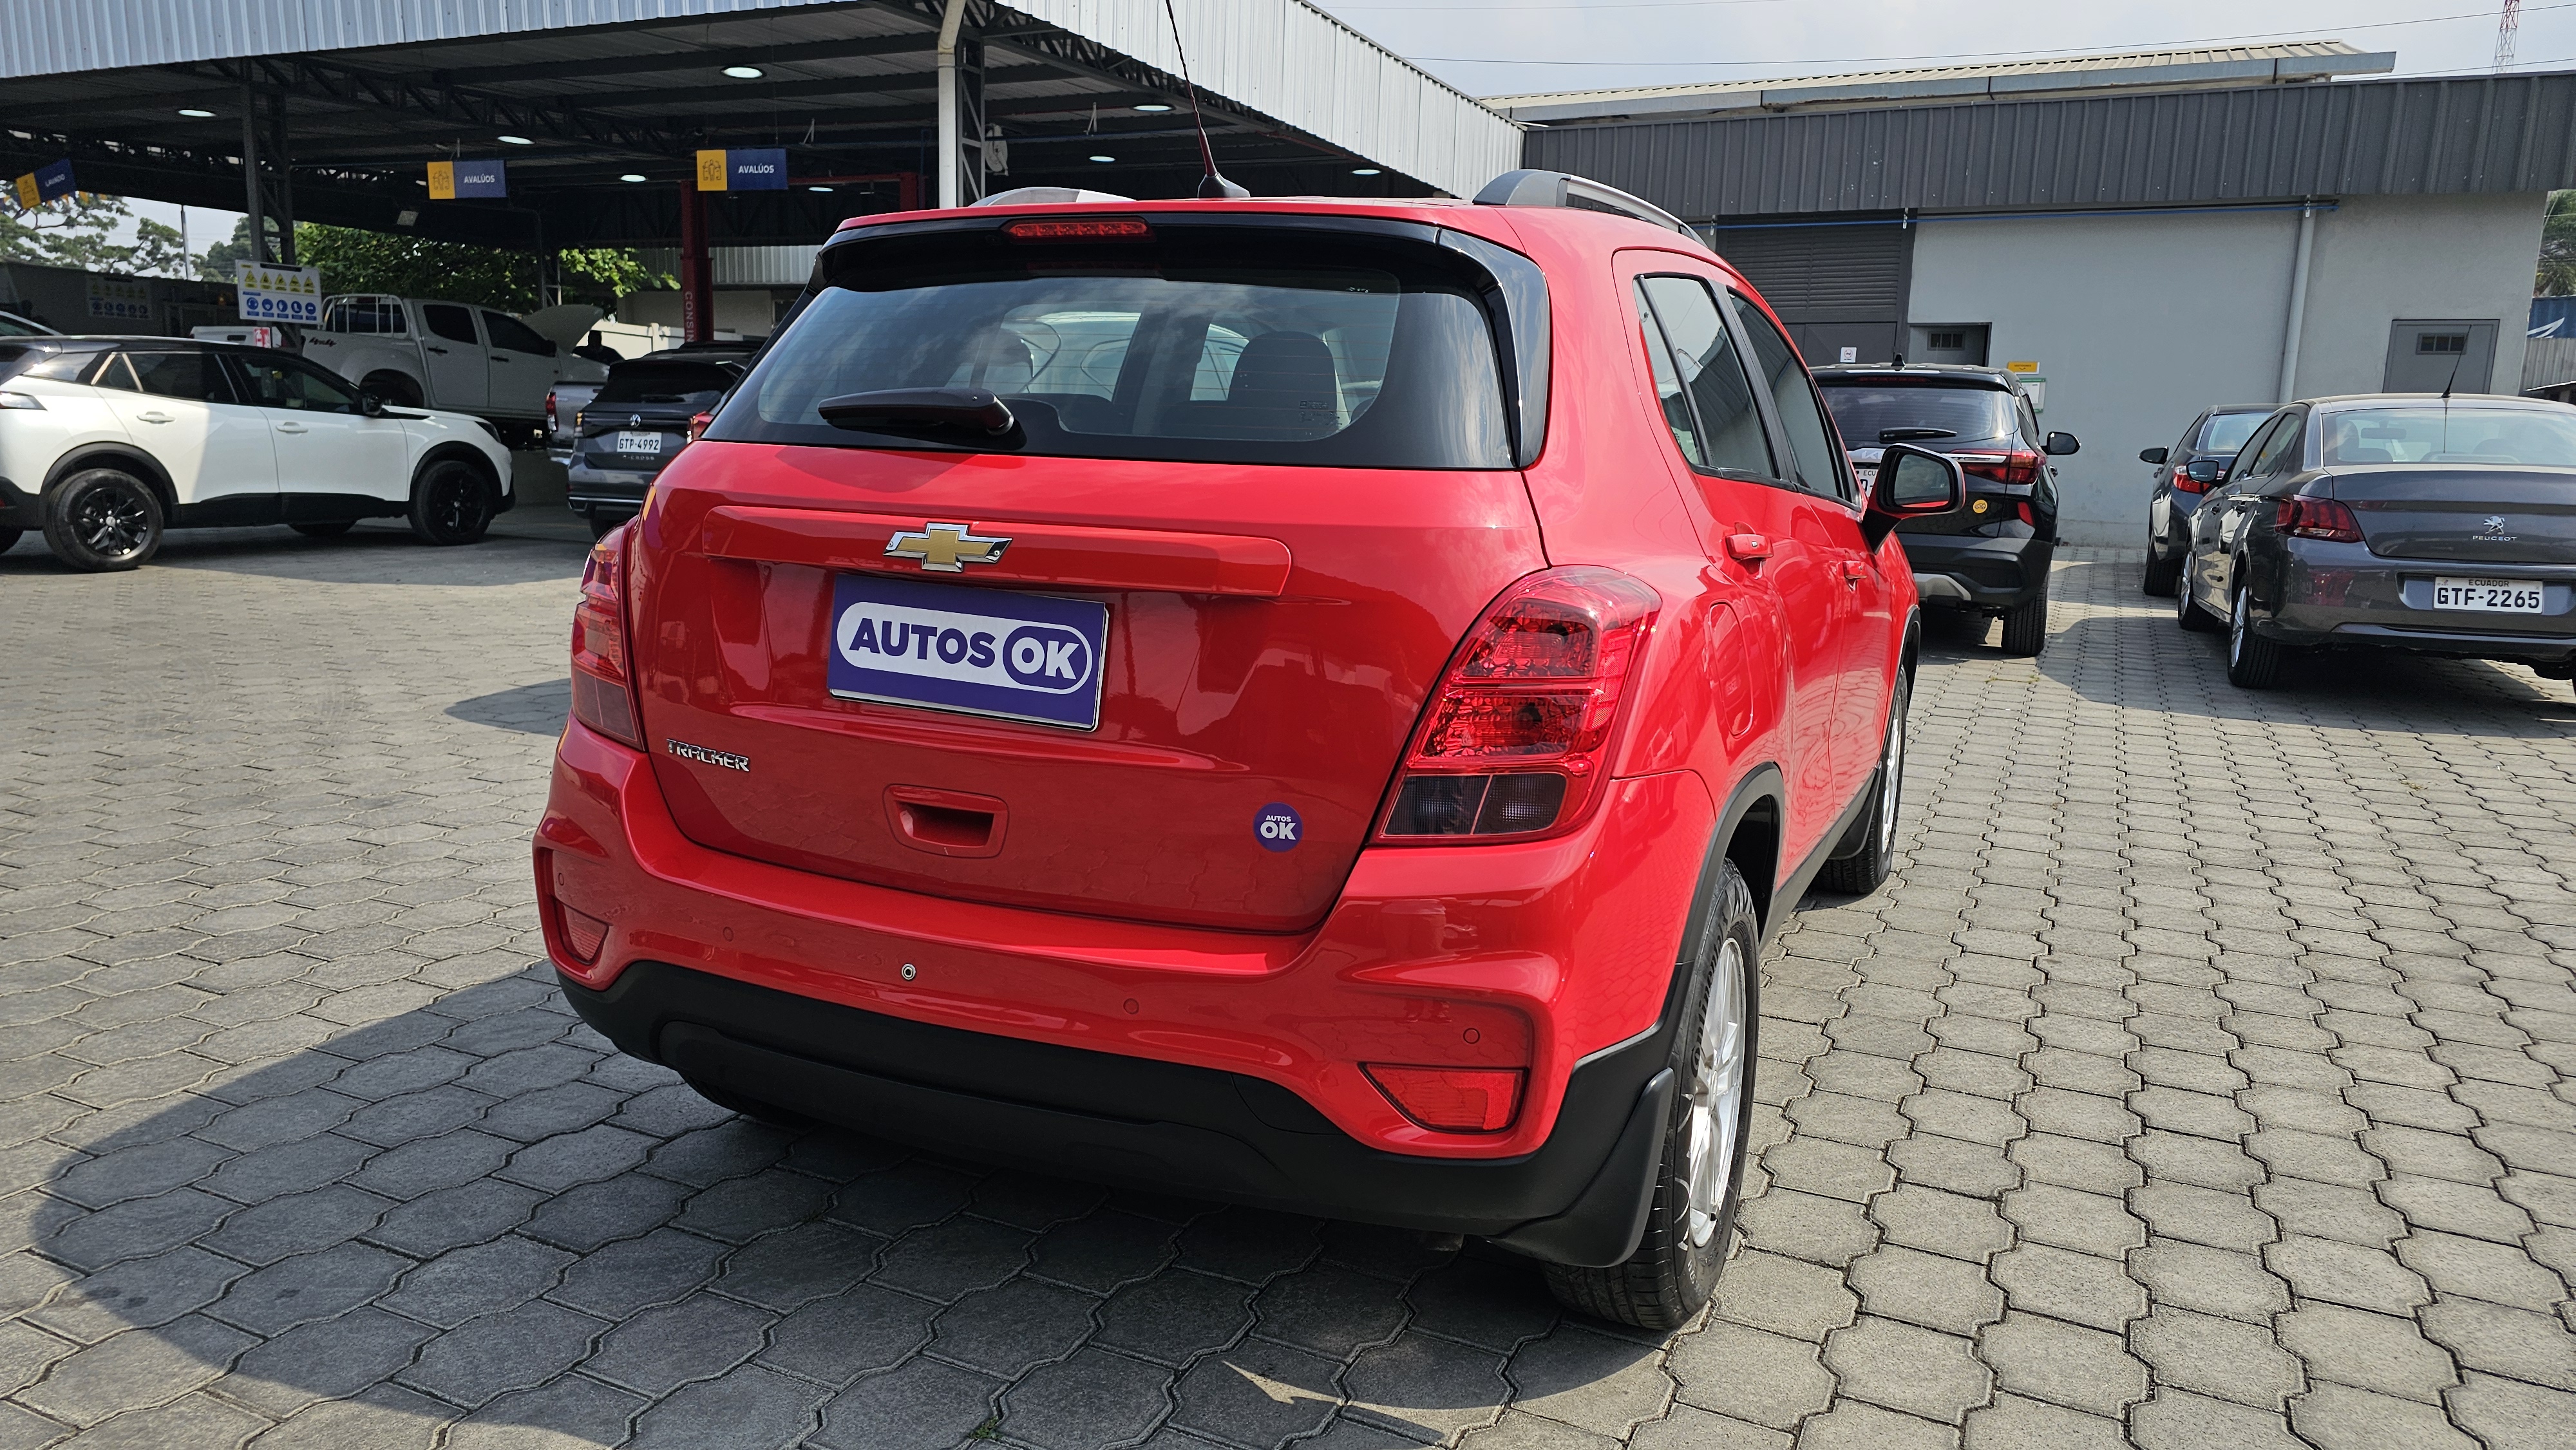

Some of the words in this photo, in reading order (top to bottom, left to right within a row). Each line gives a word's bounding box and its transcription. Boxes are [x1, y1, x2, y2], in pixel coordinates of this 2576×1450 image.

[738, 163, 775, 174] AVALÚOS
[464, 173, 495, 184] AVALÚOS
[619, 438, 659, 450] GTP-4992
[2468, 579, 2510, 587] ECUADOR
[2438, 587, 2540, 608] GTF-2265
[849, 617, 996, 668] AUTOS
[1011, 637, 1080, 680] OK
[666, 738, 750, 772] TRACKER
[1260, 821, 1296, 840] OK
